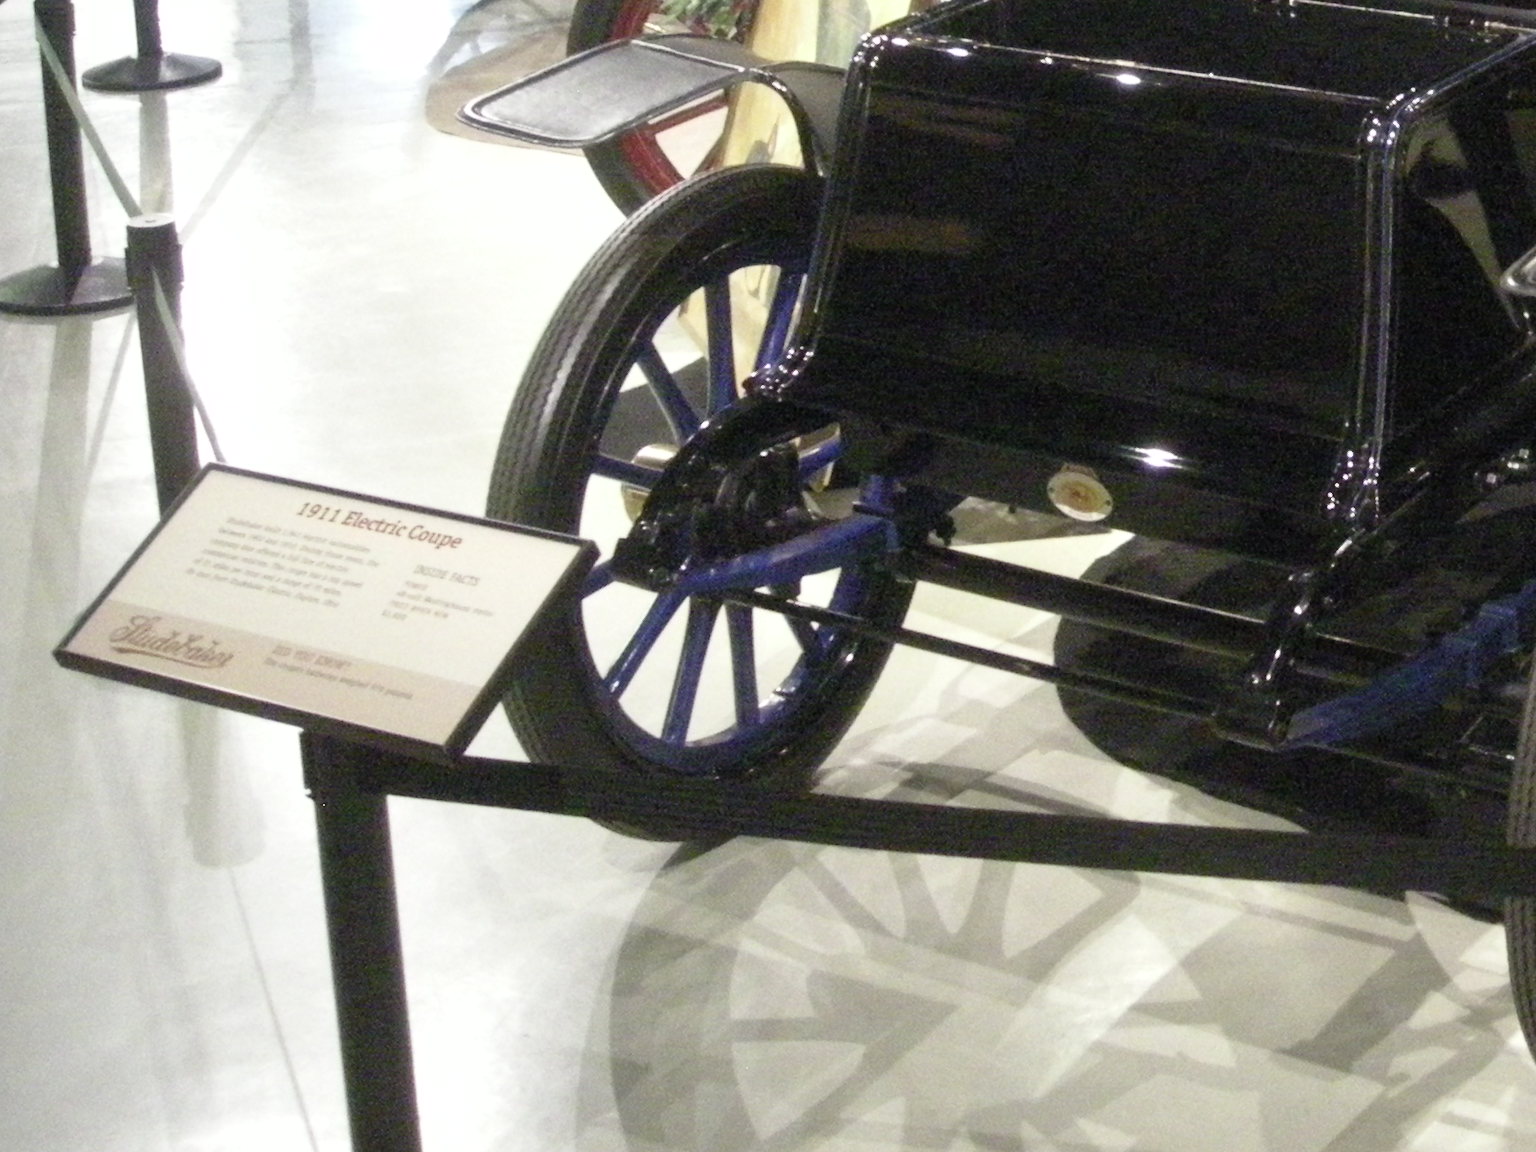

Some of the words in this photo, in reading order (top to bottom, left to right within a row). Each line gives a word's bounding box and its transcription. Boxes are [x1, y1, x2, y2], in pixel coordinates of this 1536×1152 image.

[297, 502, 341, 523] 1911
[341, 510, 407, 537] Electric
[408, 524, 463, 549] Coupe
[448, 572, 480, 587] FACTS
[109, 615, 234, 668] Studebaker
